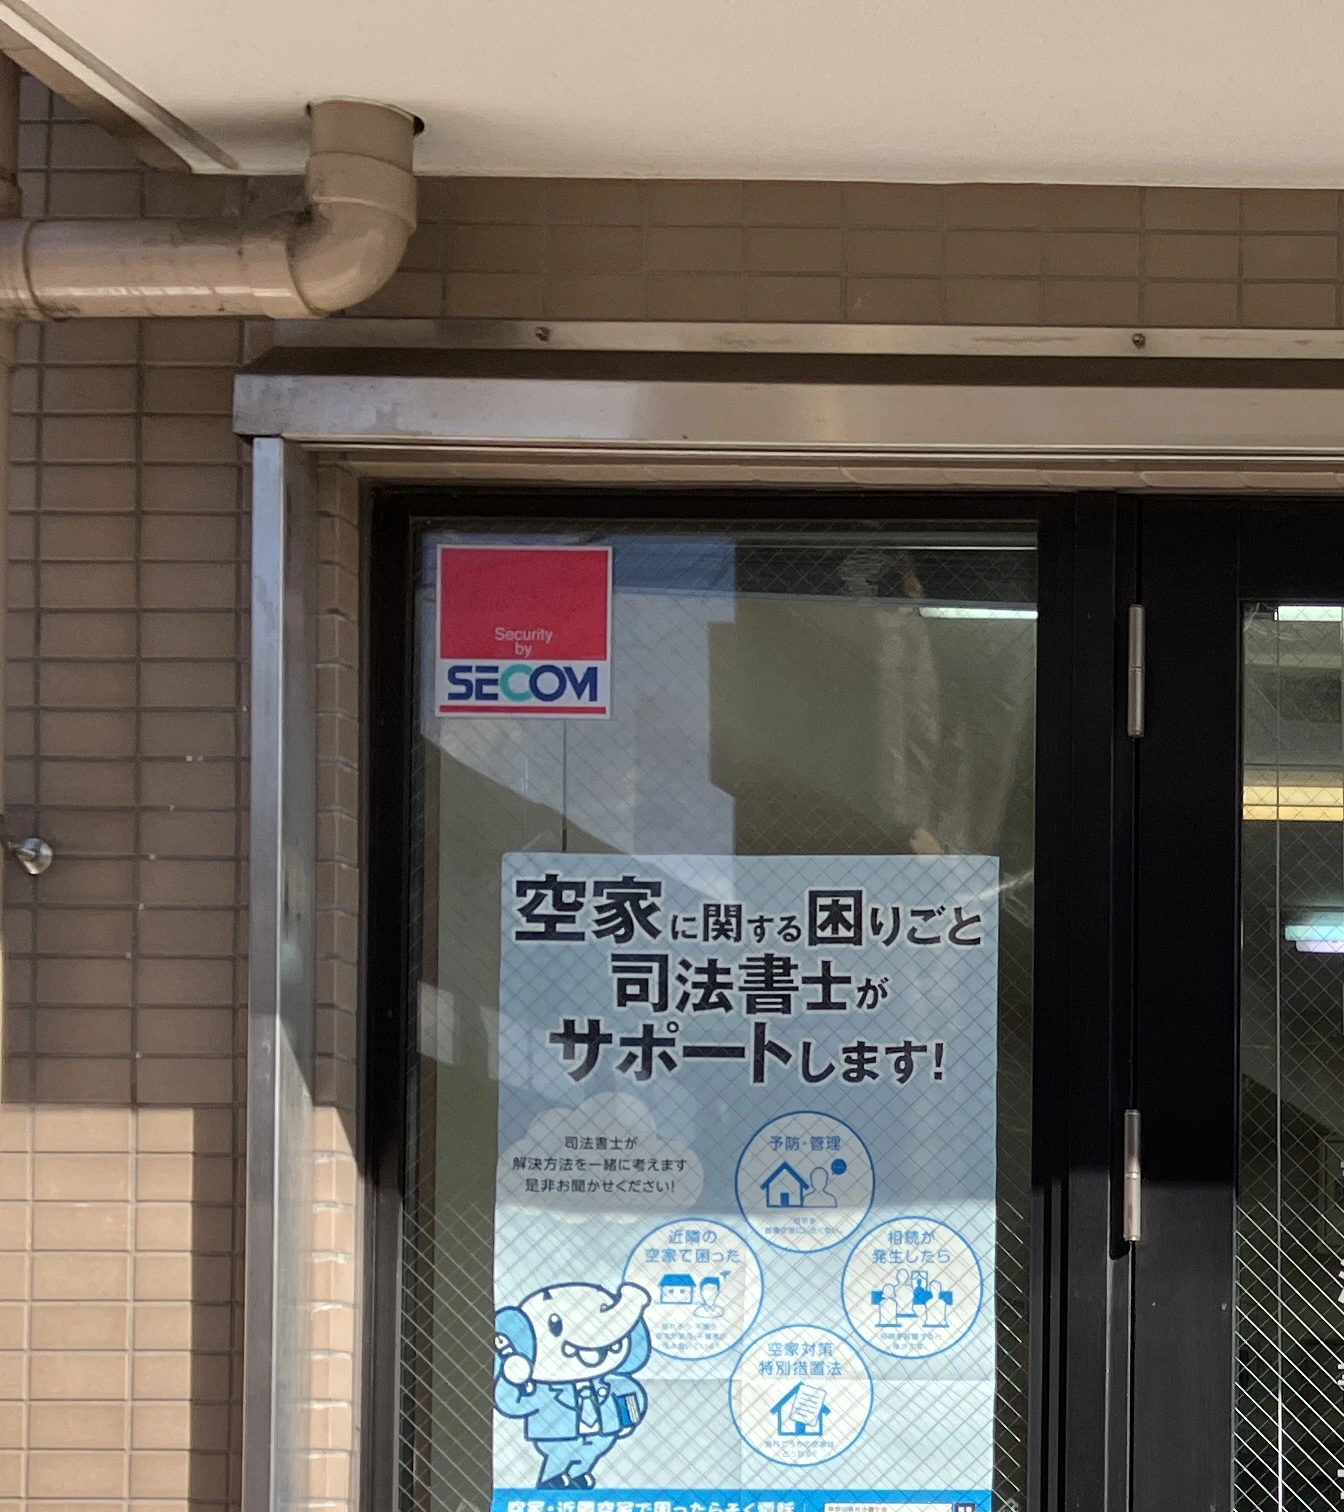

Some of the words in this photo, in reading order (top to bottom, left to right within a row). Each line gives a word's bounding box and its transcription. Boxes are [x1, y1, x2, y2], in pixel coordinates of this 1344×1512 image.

[494, 627, 553, 644] Security
[515, 642, 532, 658] by
[447, 664, 598, 702] SECOM
[514, 873, 983, 946] 空家に関する困りごと
[611, 953, 889, 1016] 司法書士が
[548, 1018, 945, 1084] サポートします!
[565, 1136, 638, 1150] 司法書士が
[769, 1135, 841, 1151] 予防・管理
[512, 1157, 687, 1172] 解決方法を一緒に考えます
[668, 1230, 718, 1244] 近隣の
[888, 1230, 936, 1245] 相続が
[645, 1248, 740, 1263] 空家で困った
[872, 1249, 950, 1264] 発生したら
[768, 1342, 833, 1356] 空家対策
[759, 1360, 841, 1376] 特別措置法
